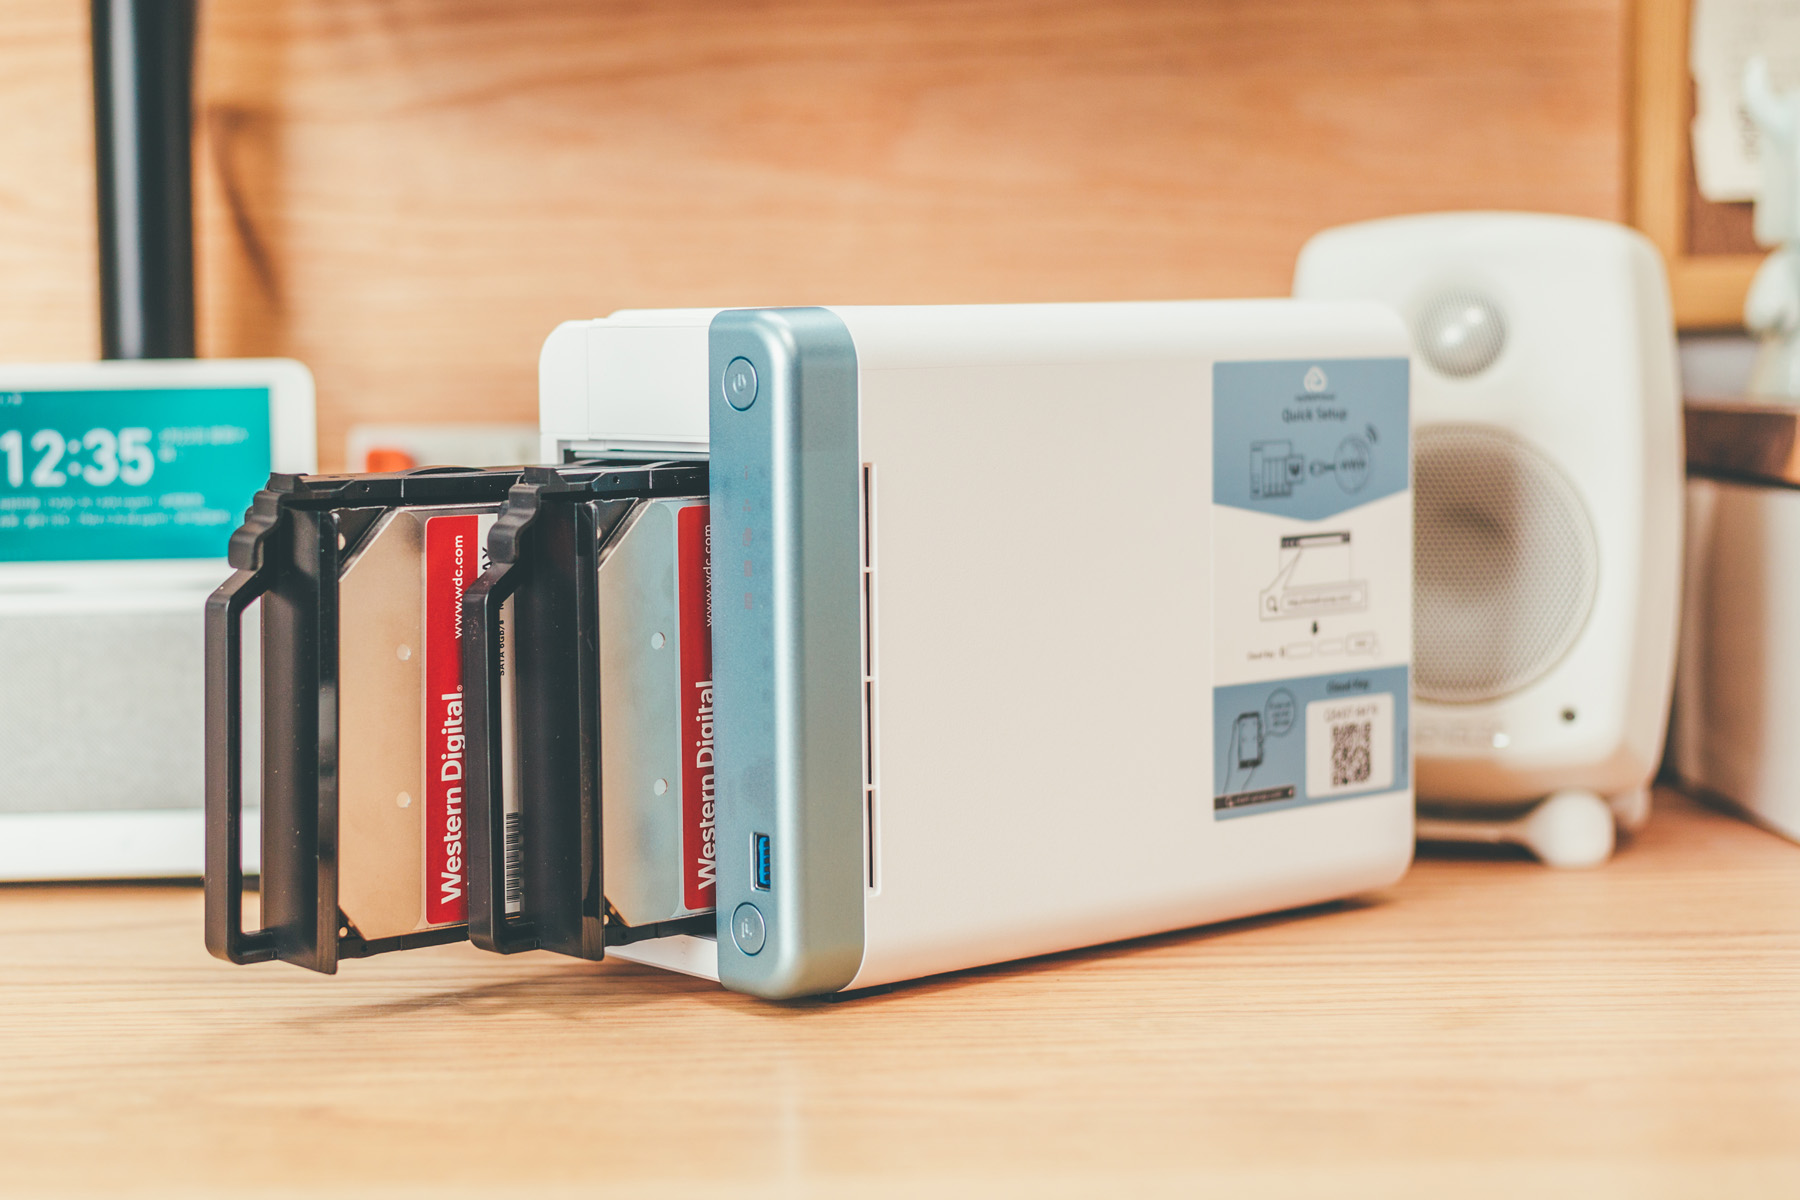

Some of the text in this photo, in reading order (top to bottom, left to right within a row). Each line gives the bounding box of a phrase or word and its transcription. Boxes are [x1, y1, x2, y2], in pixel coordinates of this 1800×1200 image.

[0, 427, 155, 488] 12:35
[1282, 407, 1348, 423] Quick Setup
[452, 535, 463, 639] www.wdc.com
[703, 524, 712, 627] wwwwdc.com
[441, 787, 462, 905] Western
[698, 770, 716, 891] Western
